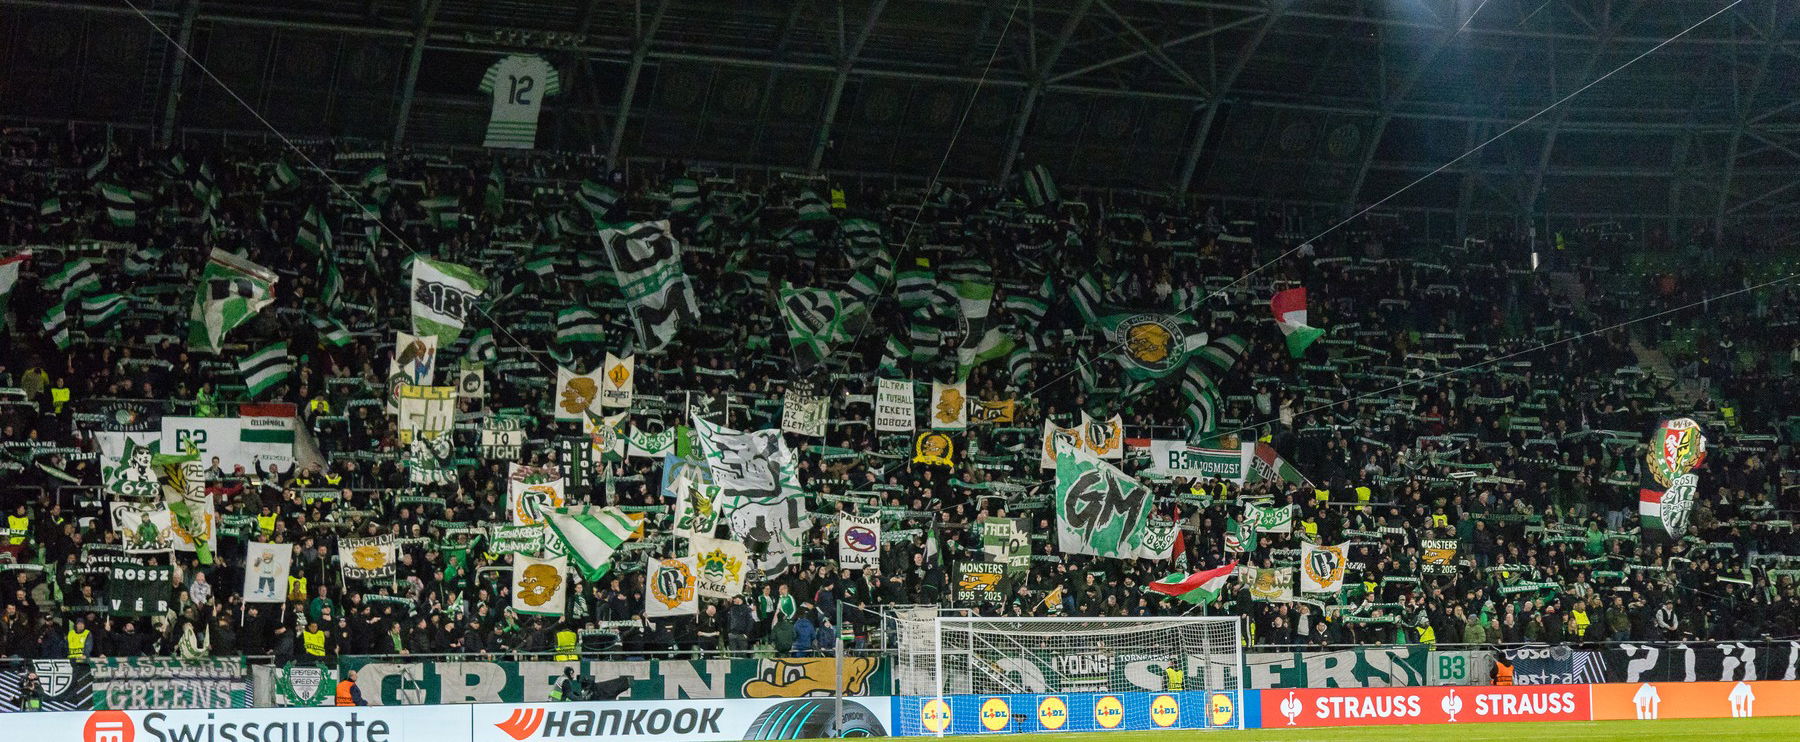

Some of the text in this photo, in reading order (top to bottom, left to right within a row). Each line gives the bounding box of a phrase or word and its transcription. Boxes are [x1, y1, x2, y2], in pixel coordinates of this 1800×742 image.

[508, 74, 534, 106] 12
[880, 380, 908, 391] ULTRA:
[484, 417, 520, 429] READY
[877, 418, 912, 427] DOBOZA
[175, 428, 208, 453] B2
[492, 433, 509, 445] TO
[562, 440, 571, 487] ANTI
[580, 442, 590, 487] VIOLA
[1168, 450, 1188, 470] B3
[121, 481, 160, 495] 648
[1064, 470, 1149, 548] GM
[985, 522, 1010, 537] FACE
[1000, 538, 1019, 555] TO
[1421, 539, 1458, 549] MONSTERS
[840, 554, 867, 565] LILÁK
[114, 568, 169, 581] ROSSZ
[959, 562, 1003, 574] MONSTERS
[958, 590, 975, 600] 1995
[984, 590, 1002, 600] 2025
[111, 597, 168, 612] VÉR
[290, 669, 321, 677] EASTERN
[1439, 655, 1466, 680] B3
[107, 680, 232, 709] GREENS
[1315, 695, 1422, 718] STRAUSS
[1475, 692, 1576, 716] STRAUSS
[142, 712, 391, 742] Swissquote
